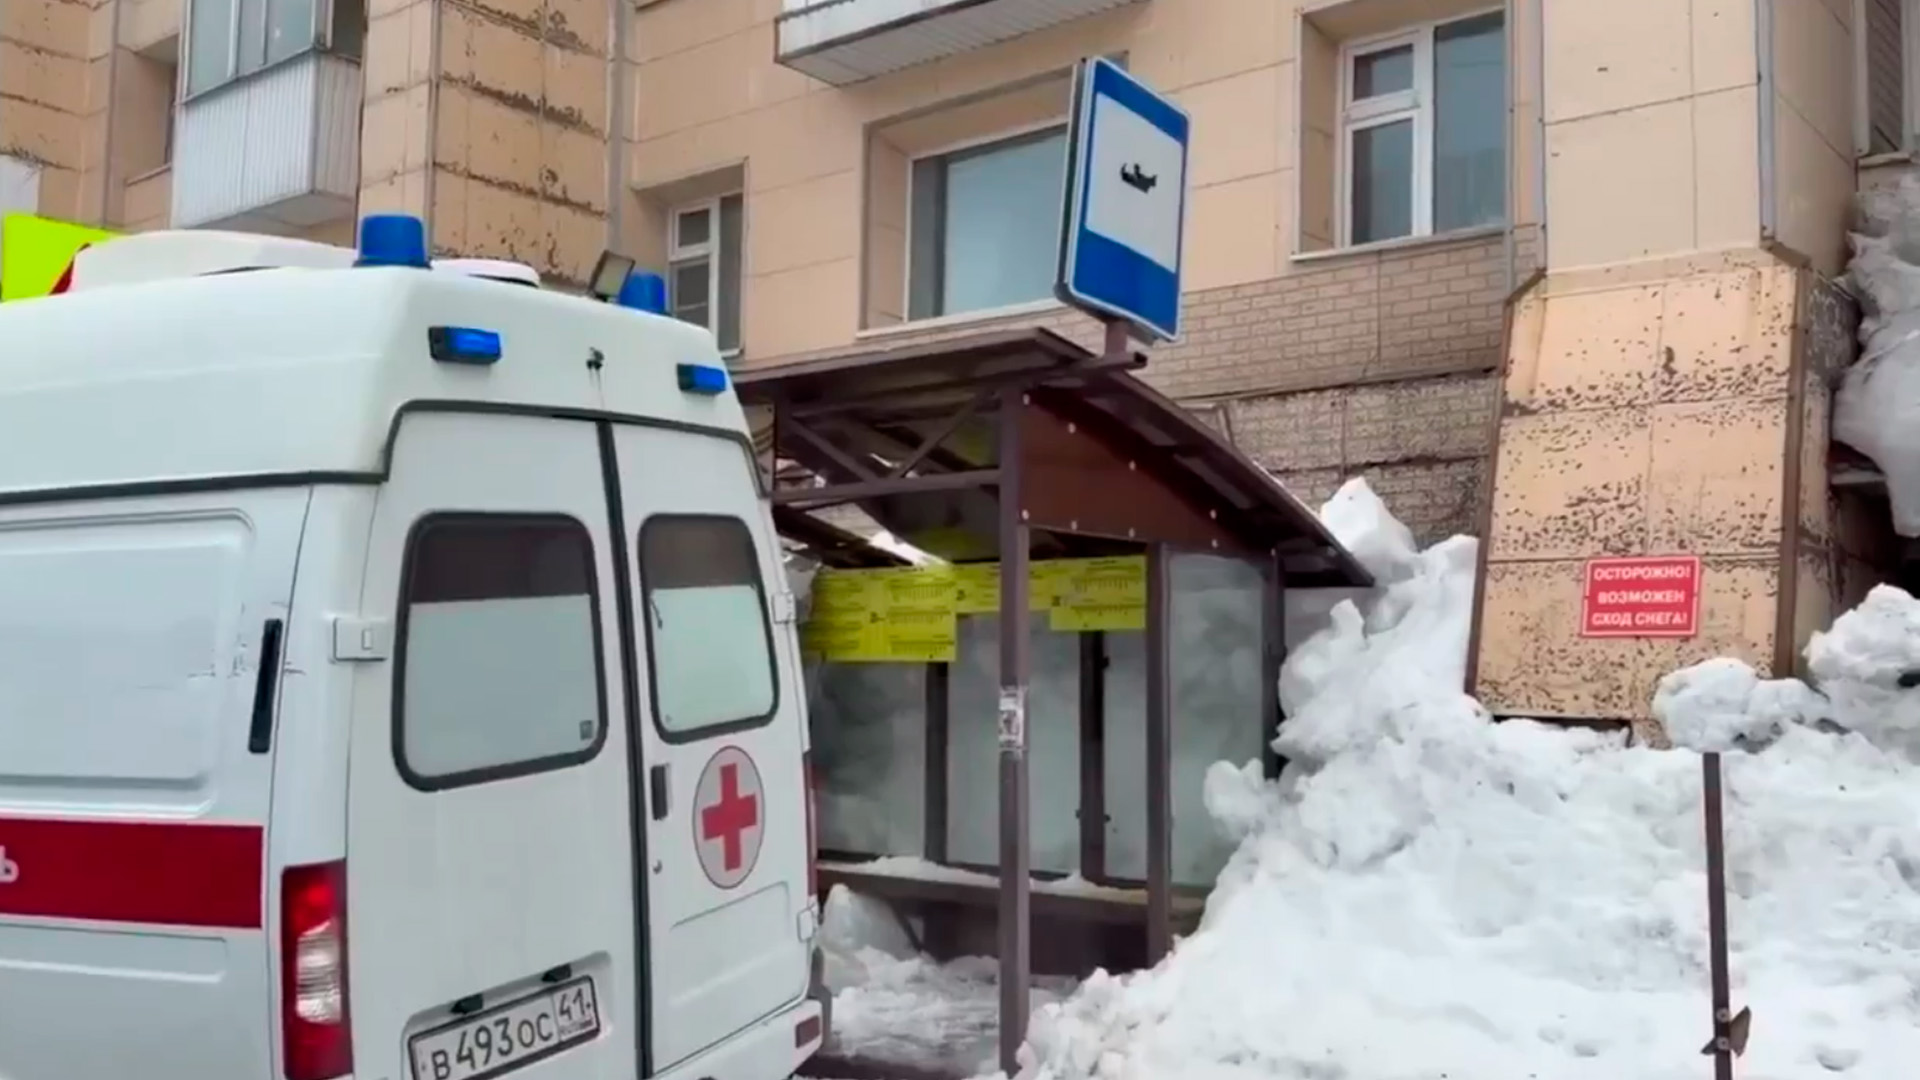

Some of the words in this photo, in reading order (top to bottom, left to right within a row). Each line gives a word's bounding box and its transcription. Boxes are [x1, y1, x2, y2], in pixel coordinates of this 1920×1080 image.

[1593, 565, 1691, 581] ОСТОРОЖНО!
[1597, 590, 1685, 604] ВОЗМОЖЕН
[1591, 612, 1632, 627] СХОД
[1635, 611, 1688, 625] СНЕГА!
